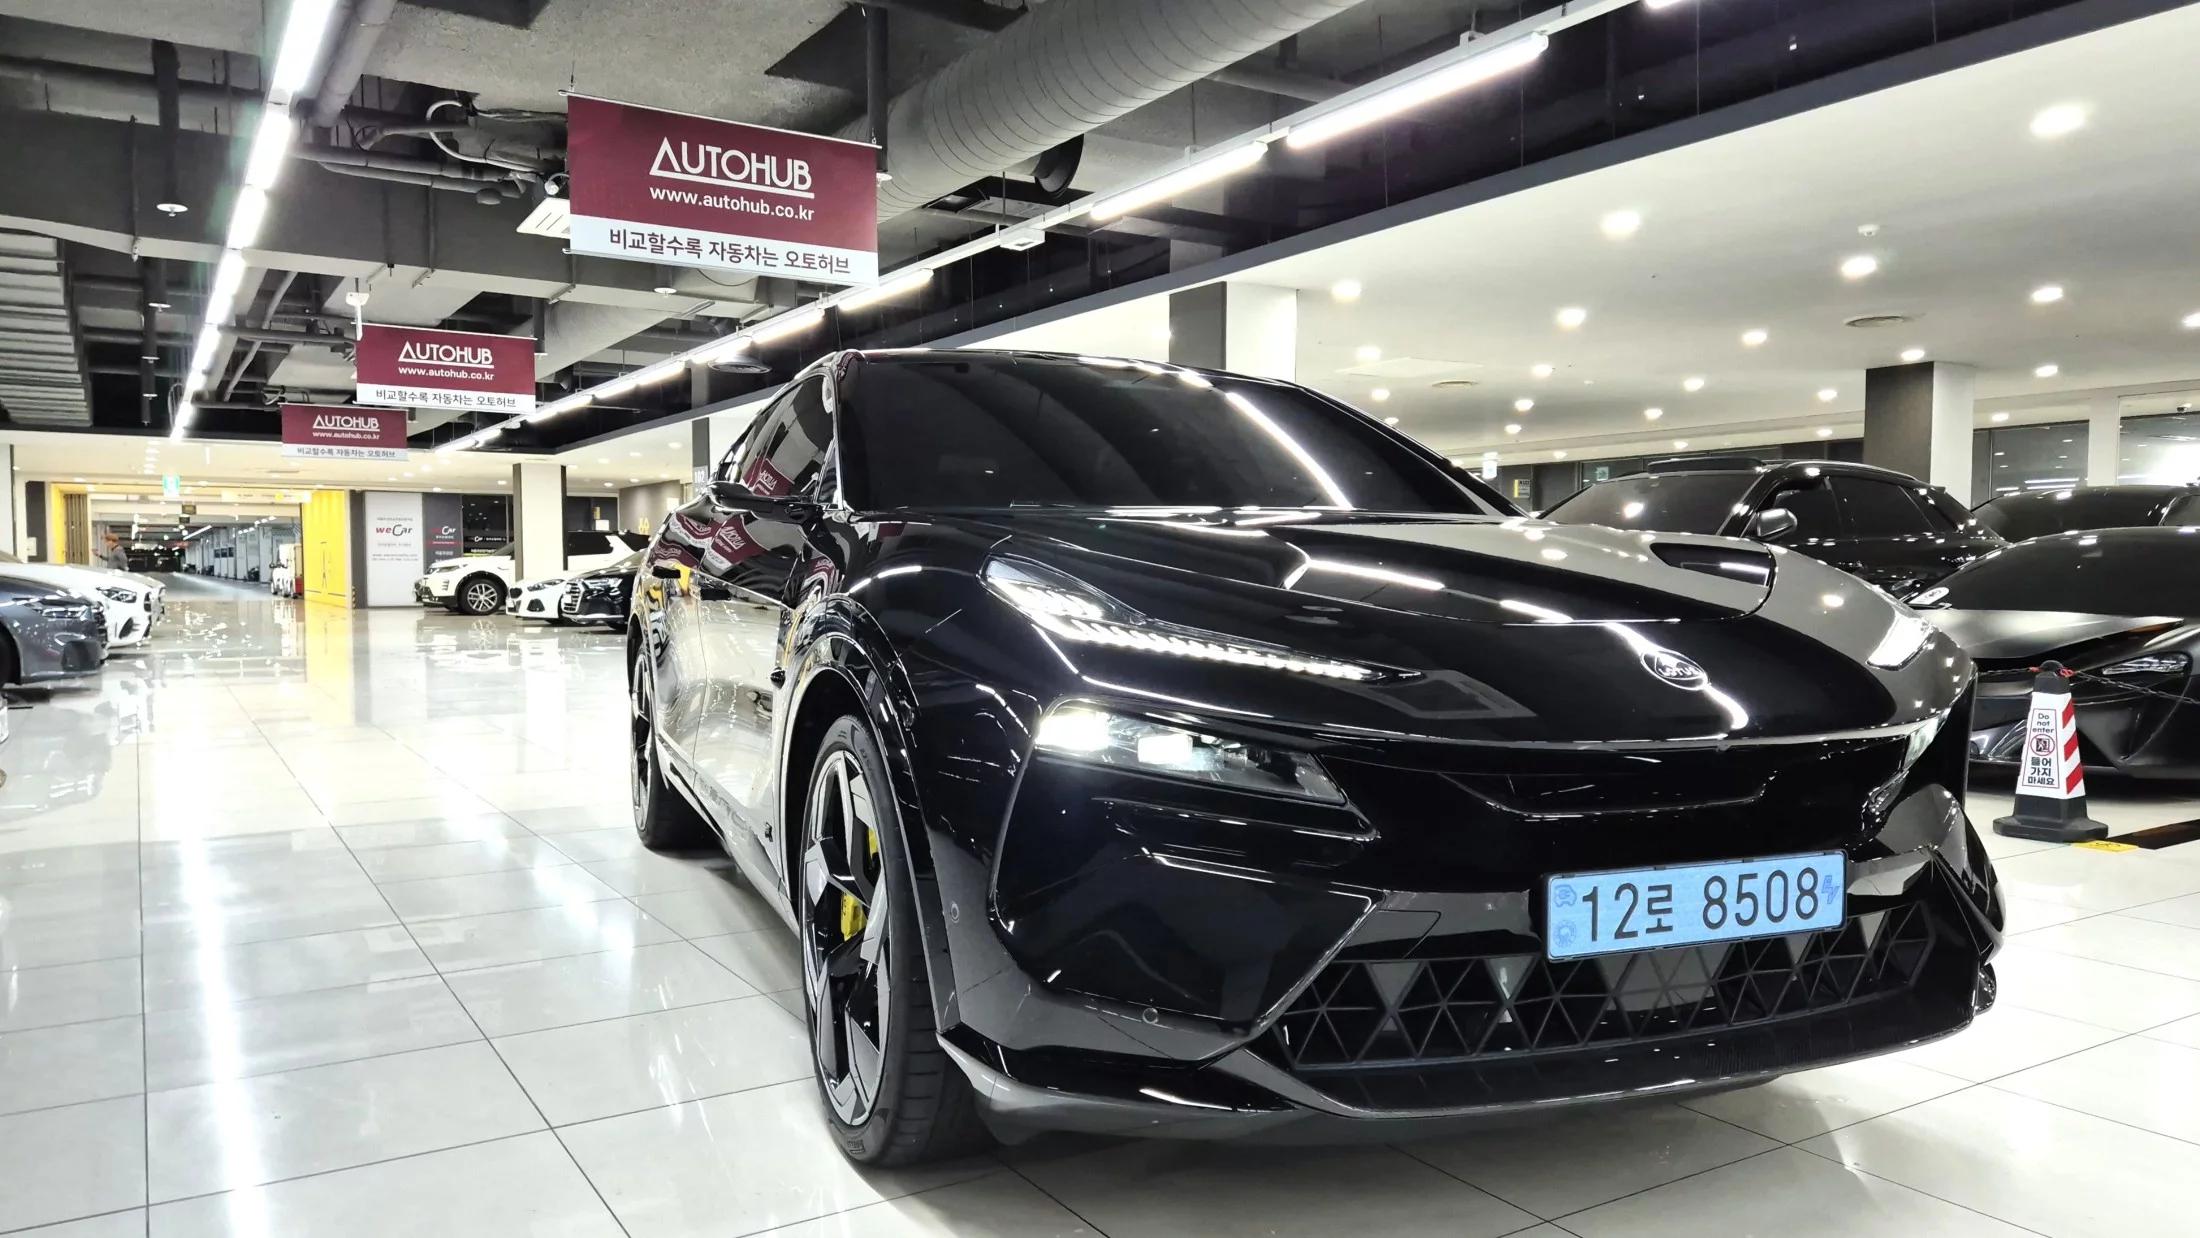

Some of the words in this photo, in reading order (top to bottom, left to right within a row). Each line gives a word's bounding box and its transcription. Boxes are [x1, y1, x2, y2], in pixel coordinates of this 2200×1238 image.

[649, 137, 814, 198] AUTOHUB
[649, 186, 814, 221] www.autohub.co.kr
[609, 229, 703, 259] 비교할수록
[708, 241, 779, 267] 자동차는
[784, 251, 851, 274] 오토허브
[398, 341, 494, 368] AUTOHUB
[398, 366, 495, 381] www.autohub.co.kr
[375, 389, 428, 403] 비교할수록
[432, 392, 473, 406] 자동차는
[477, 395, 516, 408] 오토허브
[312, 414, 380, 431] AUTOHUB
[312, 430, 380, 440] www.autohub.co.kr
[375, 524, 413, 536] weCar
[2037, 712, 2050, 720] Do
[2030, 757, 2052, 767] 들어
[2030, 767, 2051, 777] 가지
[2027, 776, 2055, 786] 마세요
[1581, 882, 1674, 943] 12로
[1701, 866, 1819, 931] 8508
